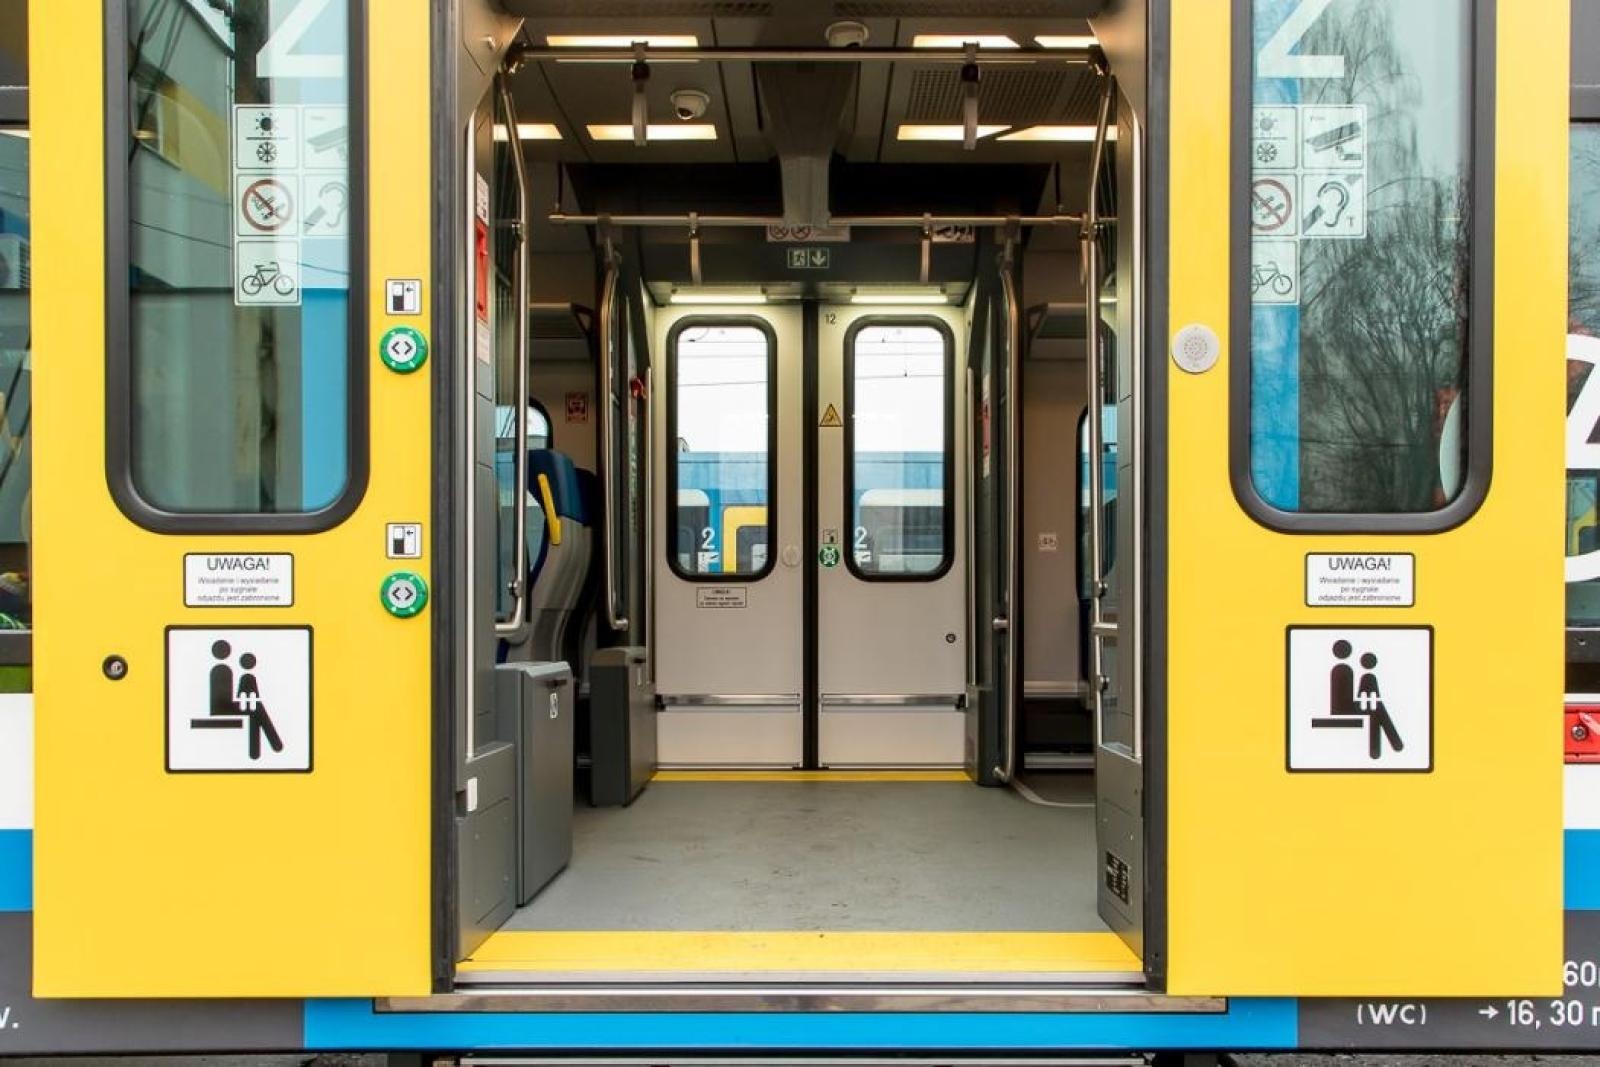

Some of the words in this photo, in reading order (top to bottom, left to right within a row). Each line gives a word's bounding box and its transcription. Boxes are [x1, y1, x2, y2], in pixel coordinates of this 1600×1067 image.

[825, 313, 836, 325] 12
[701, 527, 715, 550] 2
[854, 526, 868, 549] 2
[206, 557, 270, 571] UWAGA!
[1327, 557, 1392, 571] UWAGA!
[1563, 960, 1600, 987] 60
[1357, 1003, 1426, 1025] (WC)
[1507, 1000, 1541, 1030] 16,
[1550, 1000, 1583, 1026] 30
